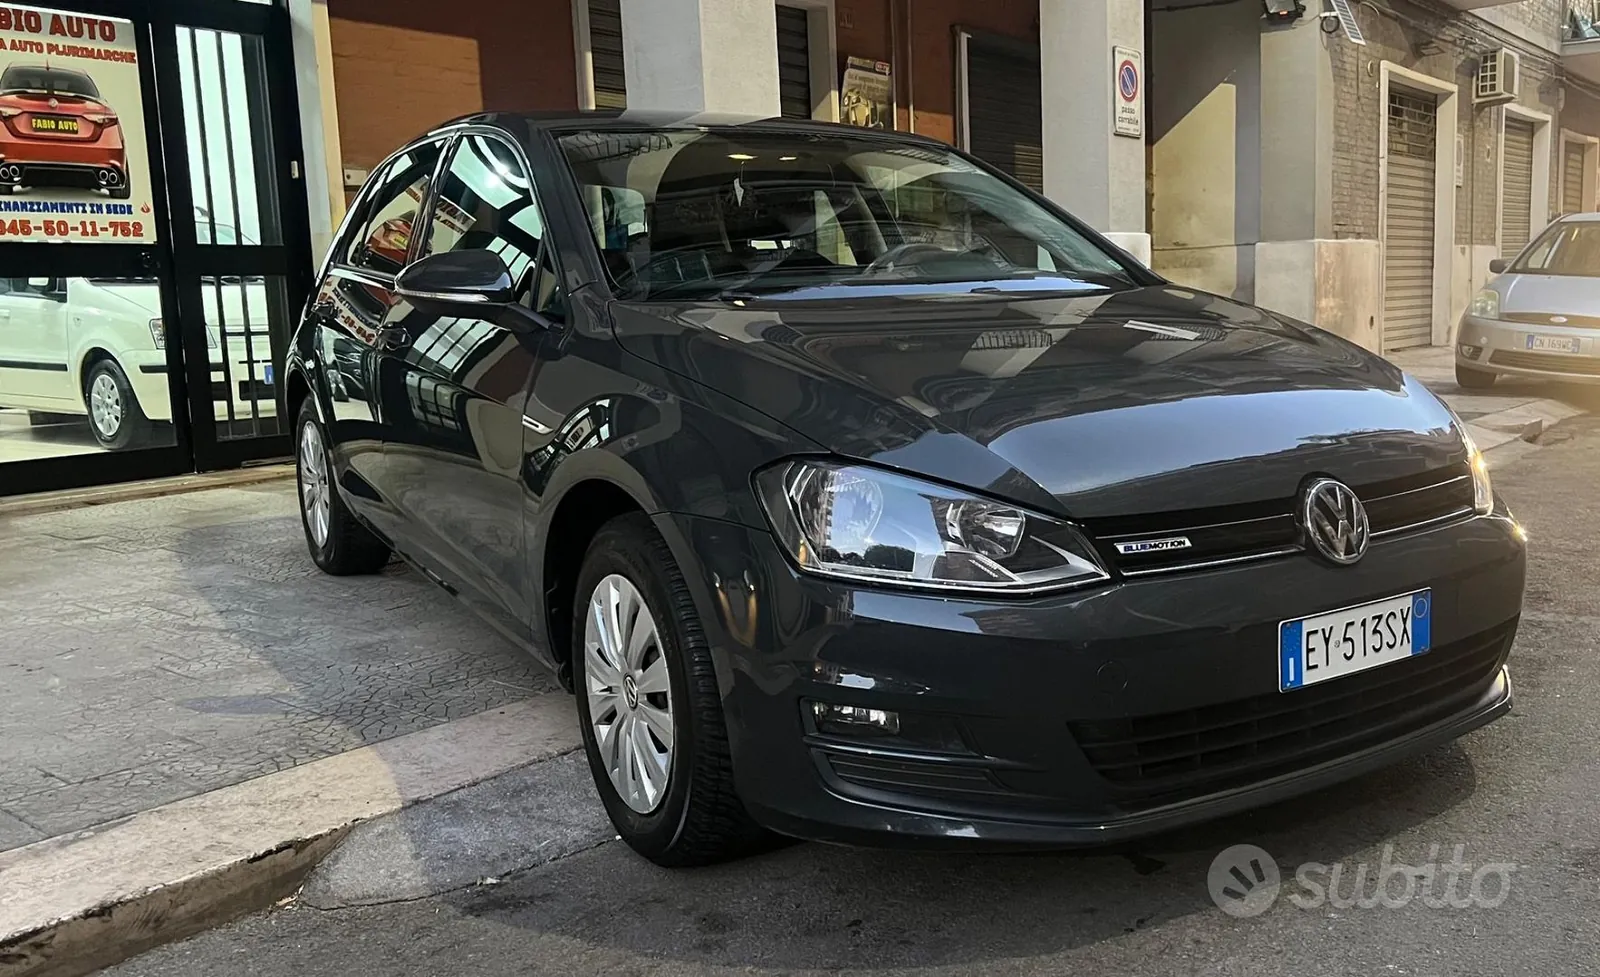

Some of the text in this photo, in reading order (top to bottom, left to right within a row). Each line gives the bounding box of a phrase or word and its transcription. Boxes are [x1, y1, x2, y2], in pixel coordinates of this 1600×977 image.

[49, 13, 116, 42] AUTO
[10, 39, 44, 54] AUTO
[46, 42, 137, 64] PLURIMARCHE
[32, 118, 78, 131] FABIO AUTO
[89, 203, 103, 215] IN
[105, 204, 133, 215] SEDE
[1123, 540, 1186, 552] BLUEMOTION
